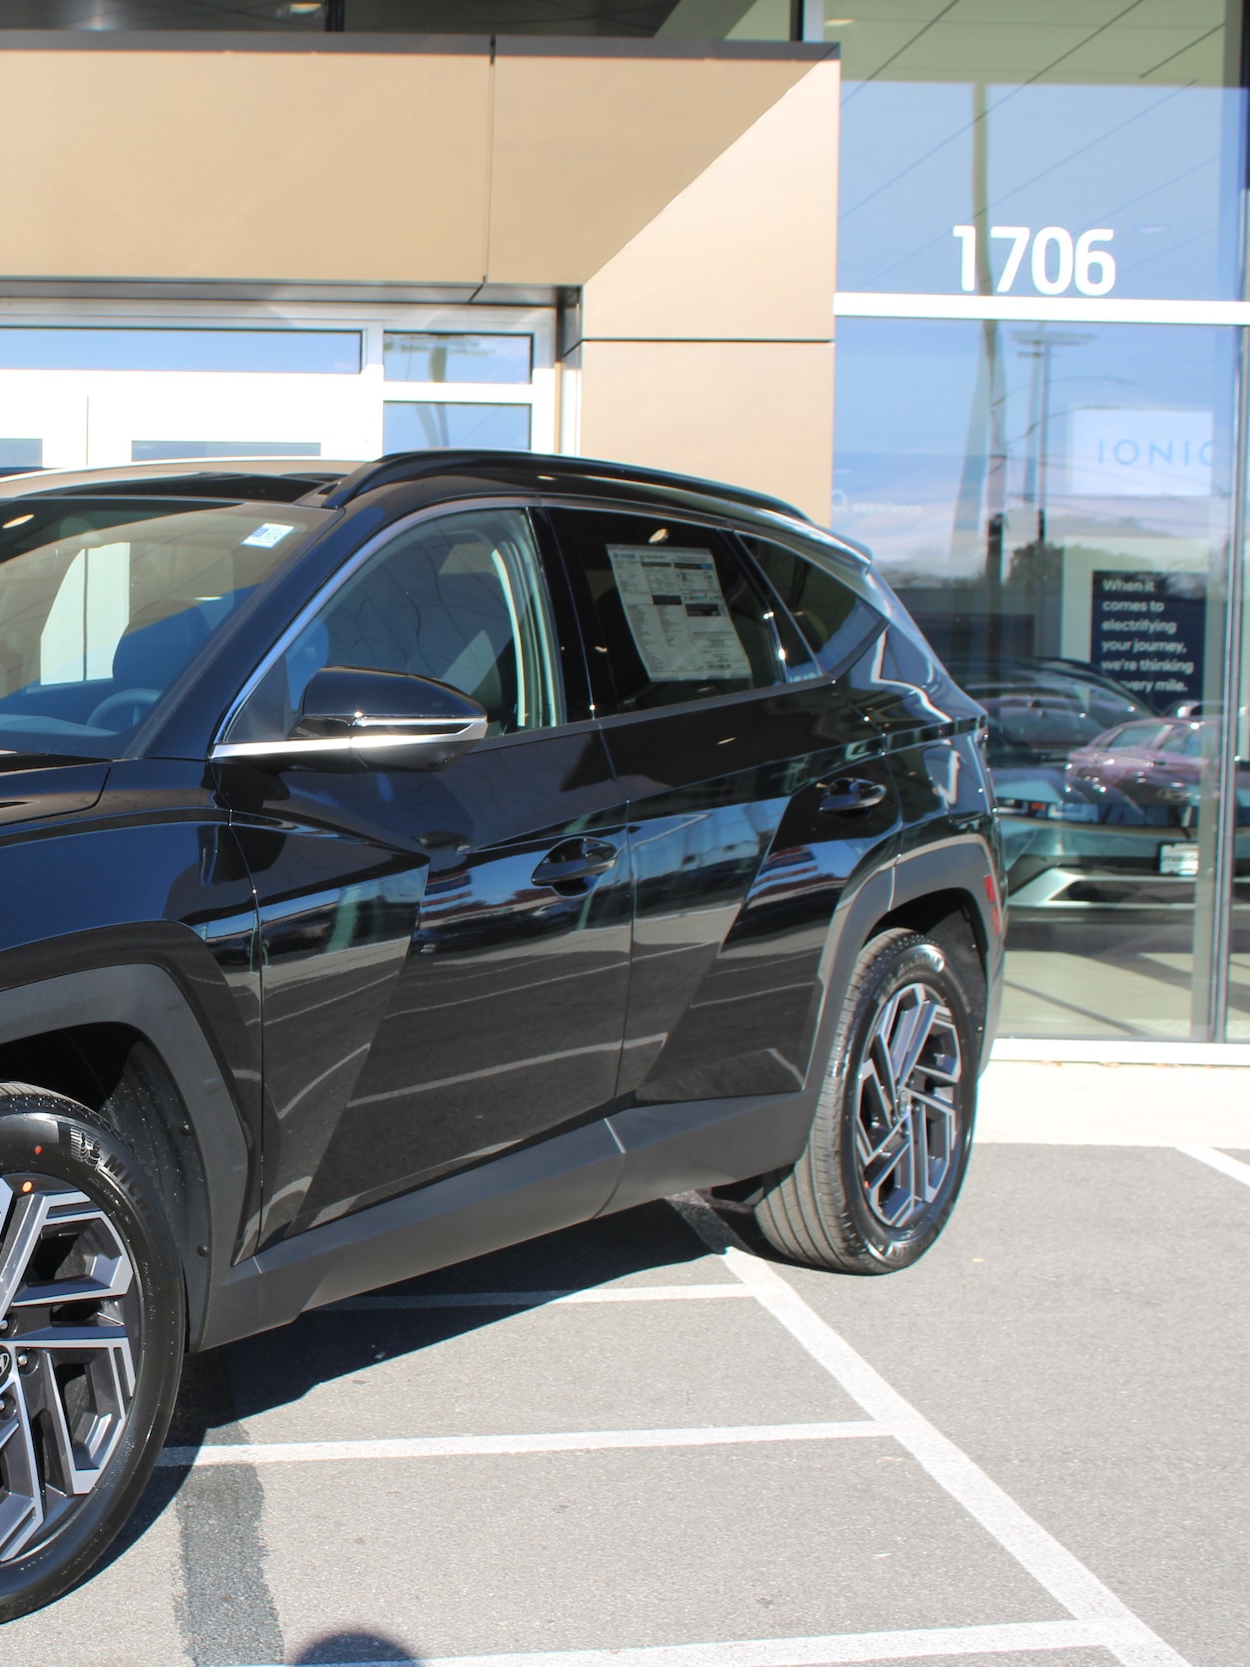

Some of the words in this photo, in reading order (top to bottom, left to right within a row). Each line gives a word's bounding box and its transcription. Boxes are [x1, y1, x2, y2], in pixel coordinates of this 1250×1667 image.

[953, 225, 1116, 296] 1706
[1102, 579, 1143, 592] When
[1144, 580, 1155, 592] it
[1102, 601, 1148, 612] comes
[1149, 600, 1164, 612] to
[1101, 619, 1177, 635] electrifying
[1101, 640, 1132, 653] your
[1132, 638, 1187, 654] journey,
[1100, 659, 1137, 671] we're
[1139, 659, 1194, 675] thinking
[1119, 680, 1154, 693] very
[1154, 678, 1188, 691] mile.
